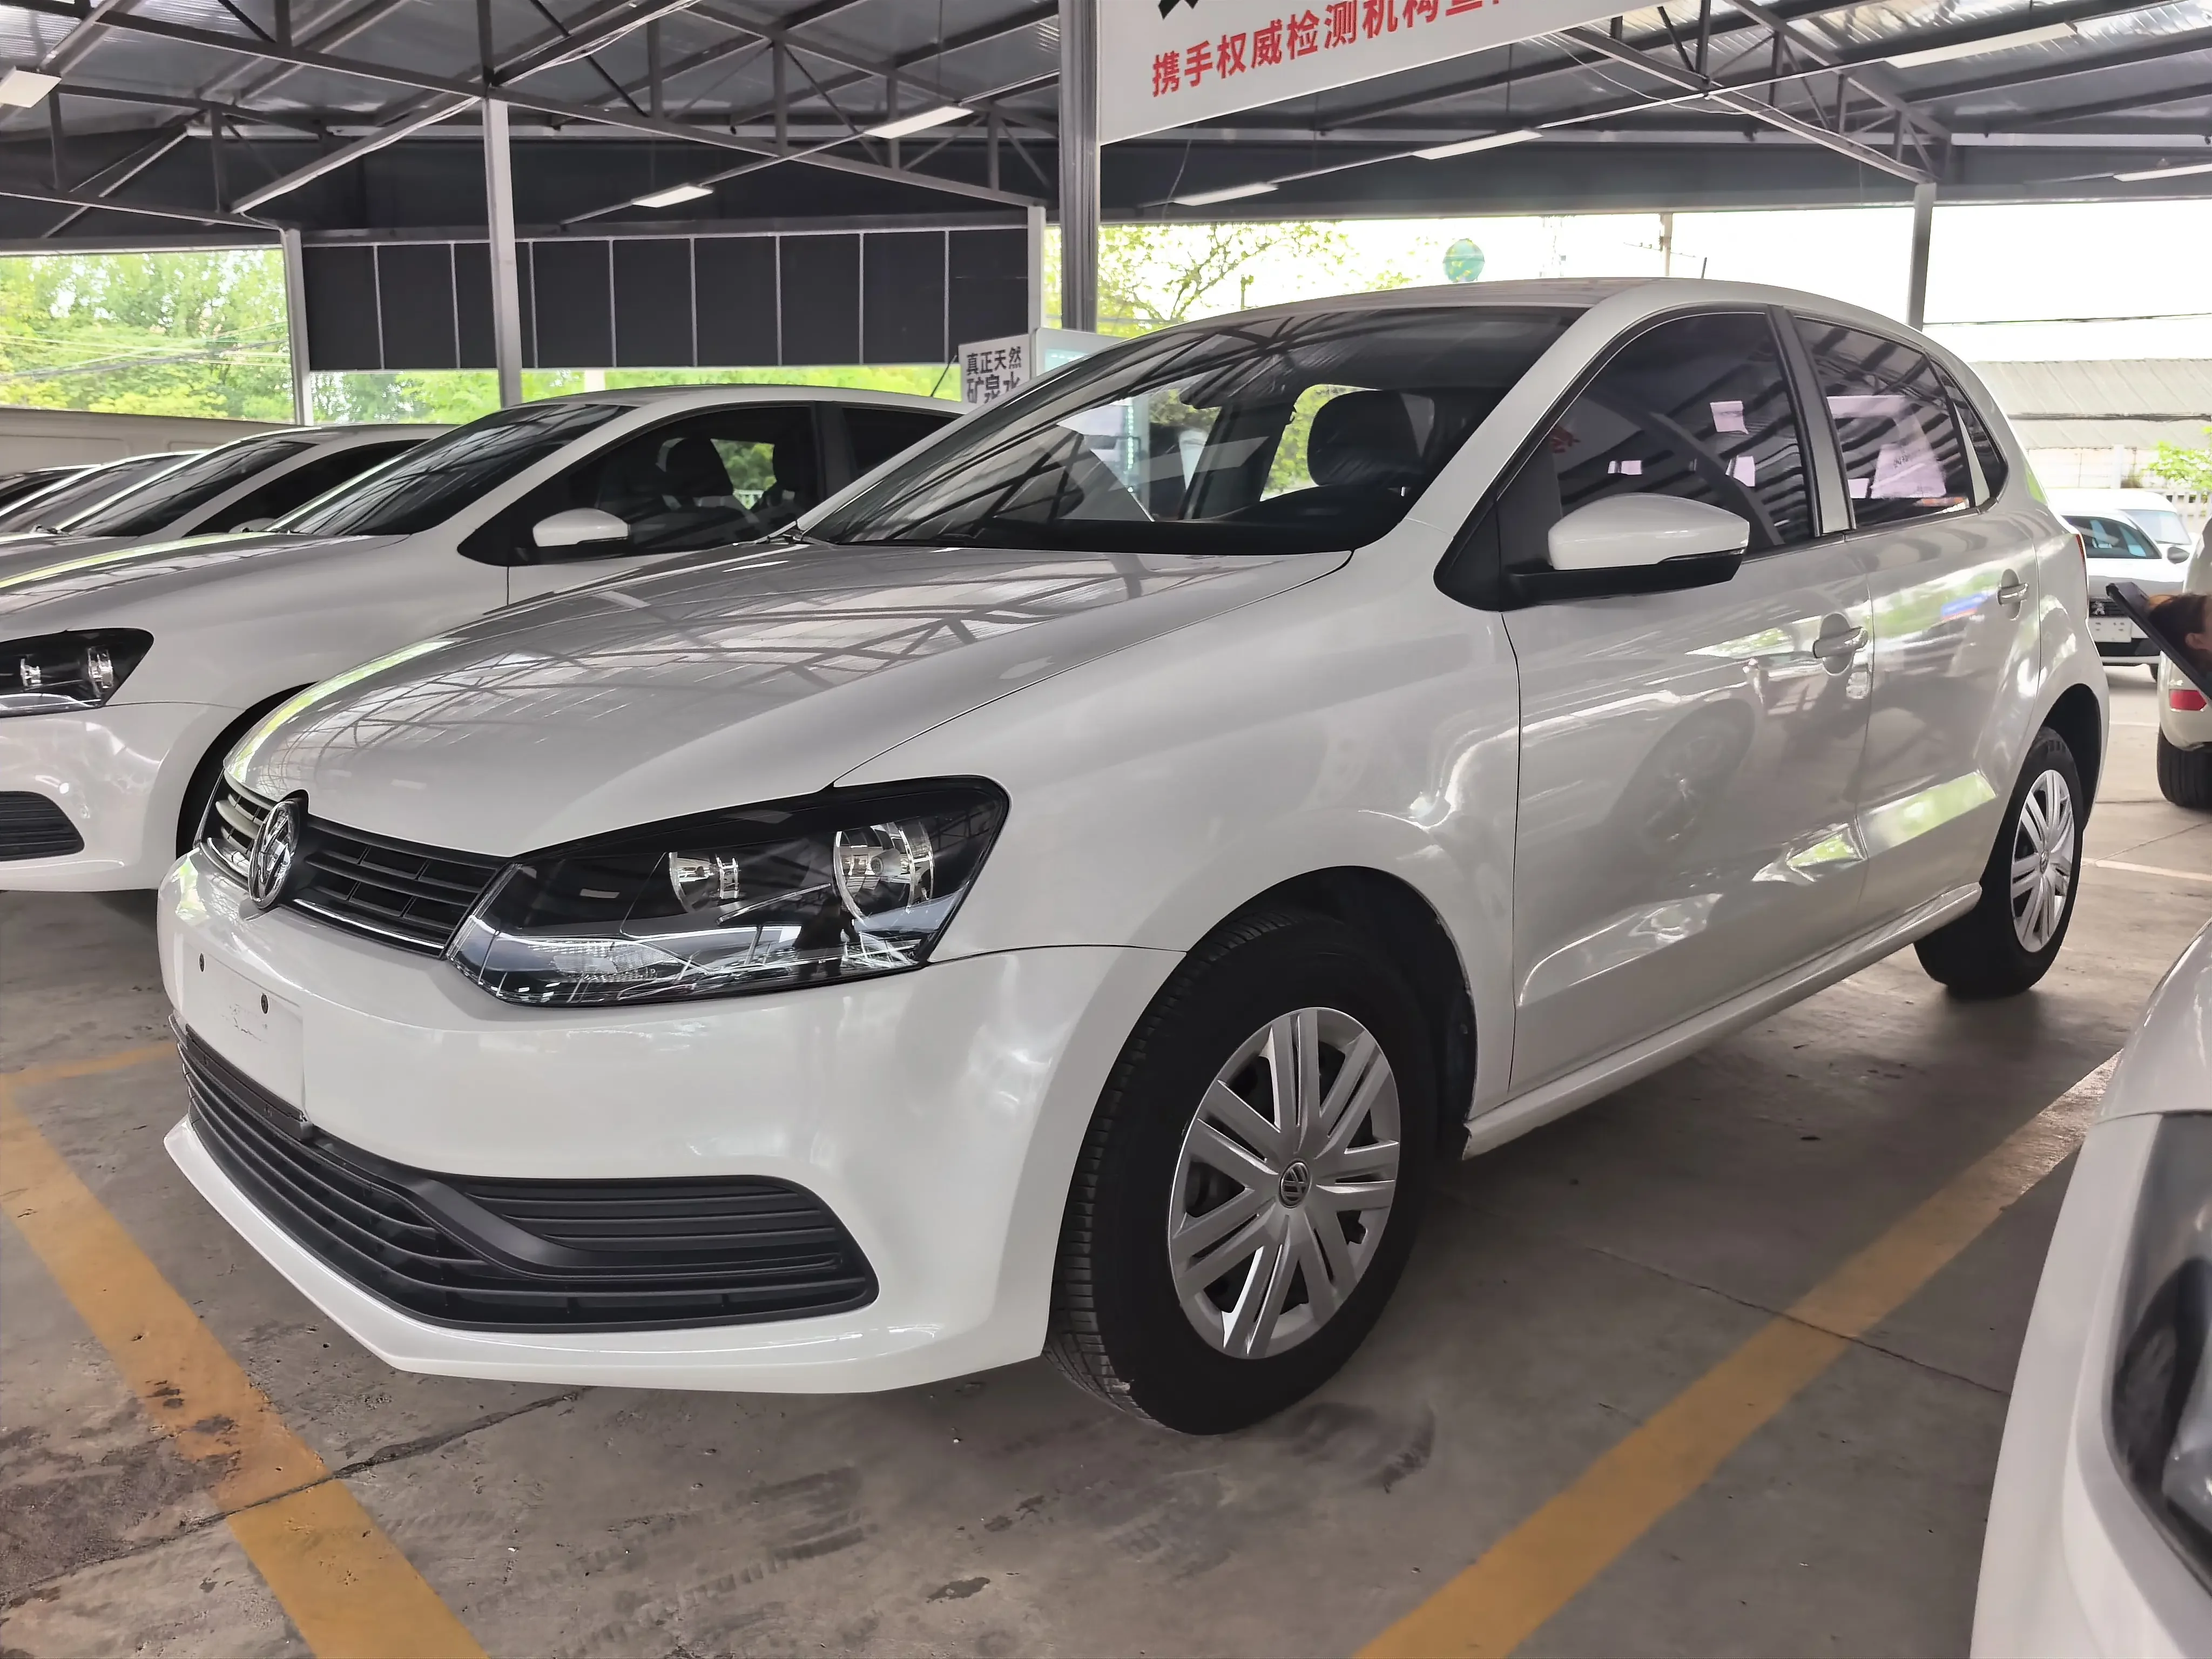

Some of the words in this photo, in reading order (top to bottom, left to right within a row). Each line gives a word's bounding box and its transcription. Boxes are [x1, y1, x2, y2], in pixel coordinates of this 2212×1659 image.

[1152, 0, 1499, 97] 携手权威检测机构
[966, 346, 1022, 375] 真正天然
